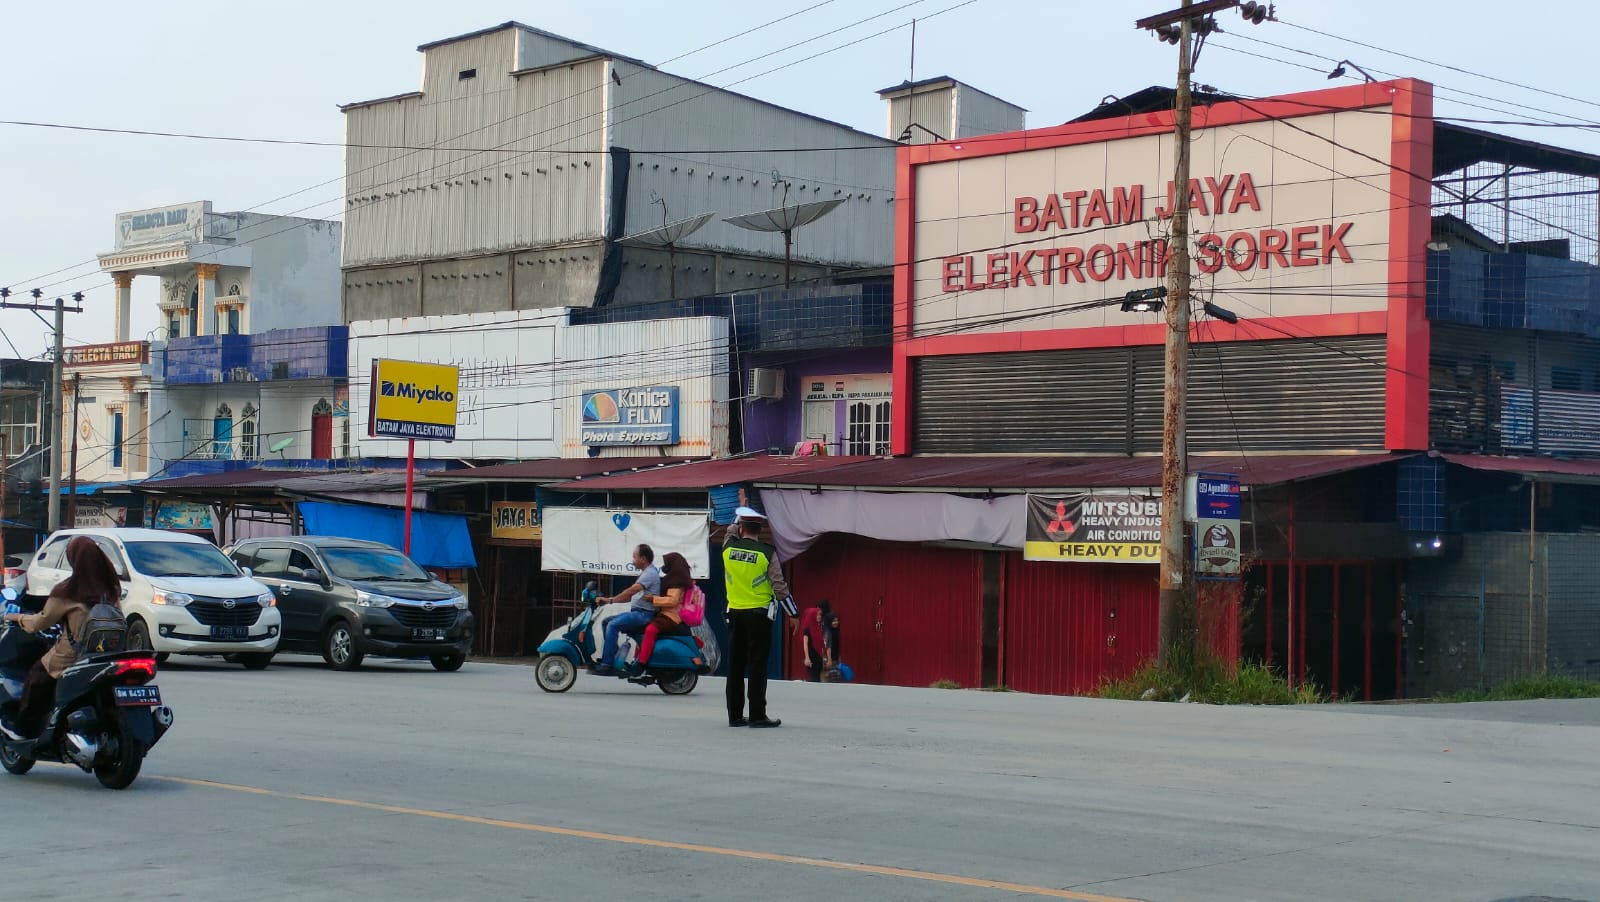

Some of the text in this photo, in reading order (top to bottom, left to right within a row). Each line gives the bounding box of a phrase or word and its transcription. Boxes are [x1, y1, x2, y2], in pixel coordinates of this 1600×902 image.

[1014, 172, 1261, 234] BATAM JAYA
[942, 222, 1354, 292] ELEKTRONIK SOREK
[72, 343, 138, 363] SELECTA BARU
[396, 382, 454, 404] Miyako
[618, 388, 670, 408] Konica
[627, 407, 662, 424] FILM
[377, 420, 455, 438] BATAM JAYA ELEKTRONIK
[583, 431, 614, 442] Photo
[495, 506, 526, 529] JAYA
[1081, 516, 1162, 527] HEAVY INDUS
[1086, 530, 1161, 541] AIR CONDITIO
[1059, 544, 1161, 558] HEAVY DU
[581, 560, 623, 571] Fashion
